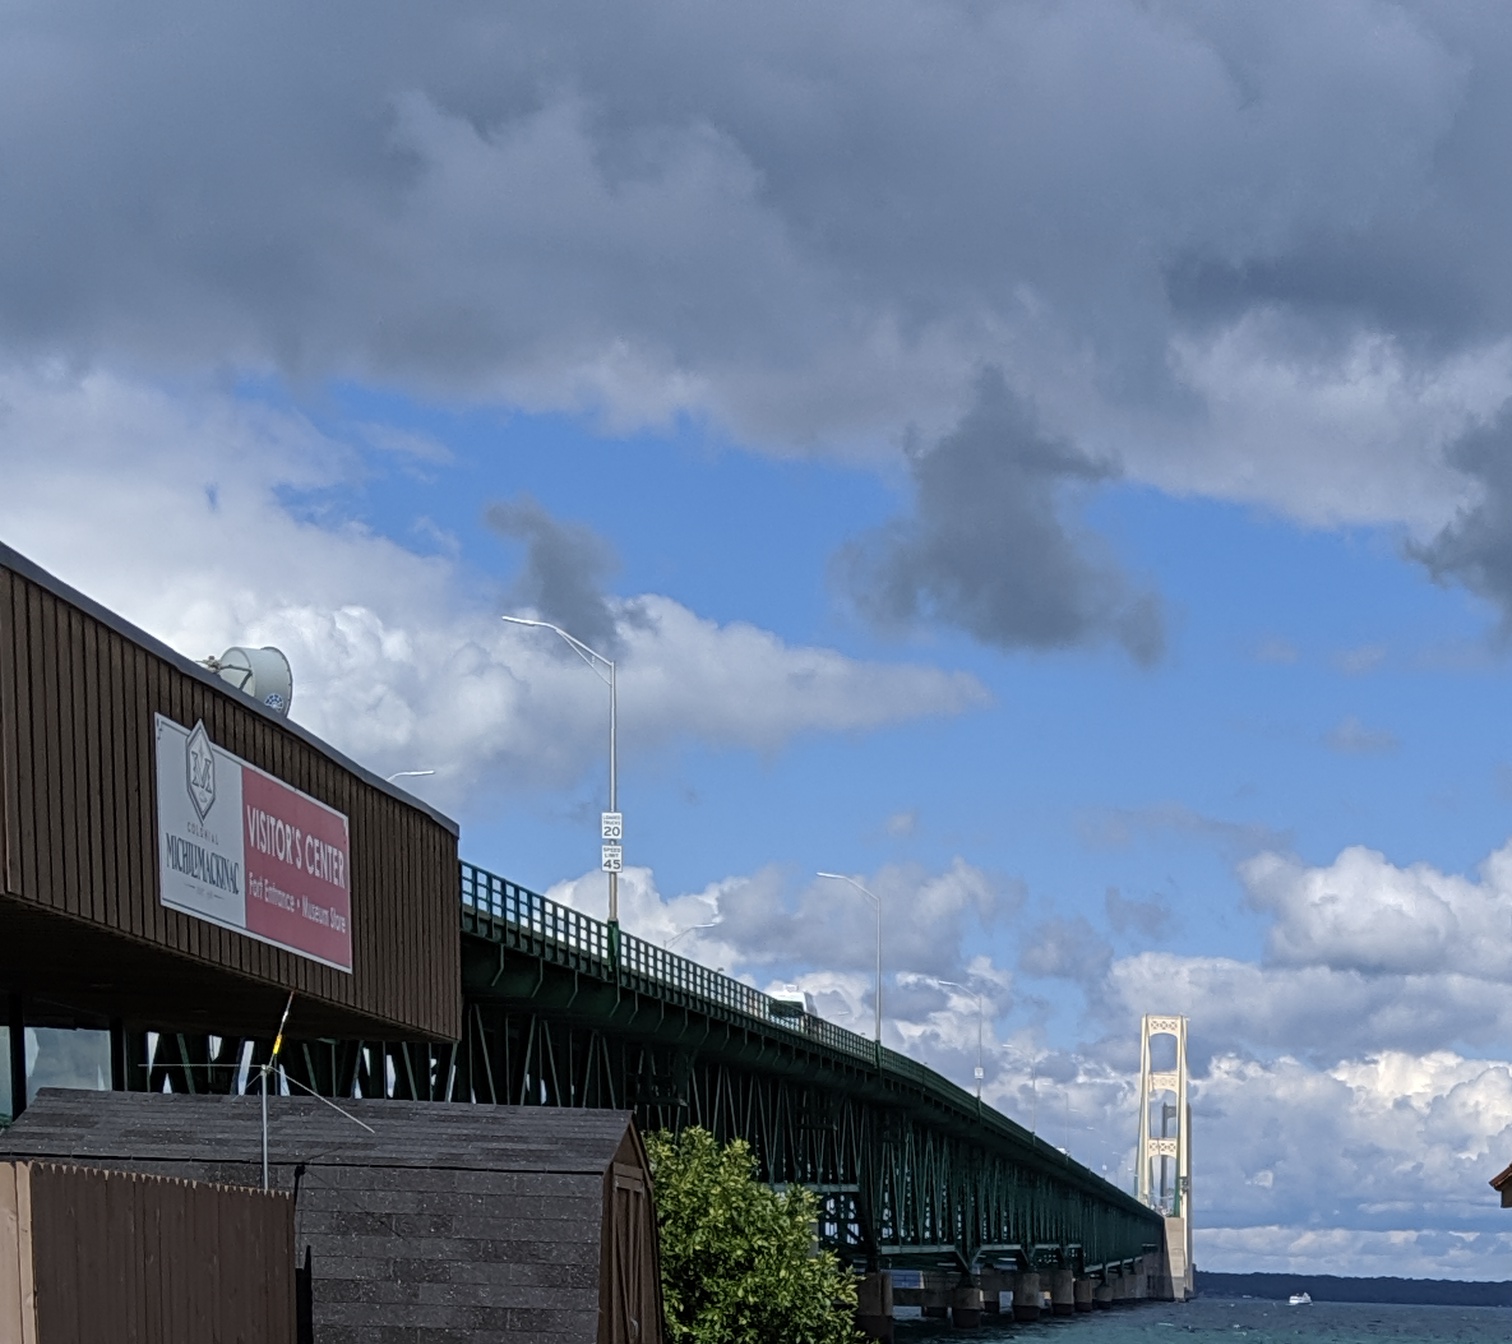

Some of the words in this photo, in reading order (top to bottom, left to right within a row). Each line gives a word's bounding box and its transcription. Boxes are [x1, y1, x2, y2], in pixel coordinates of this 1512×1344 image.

[186, 821, 219, 846] COLONIAL
[603, 826, 620, 837] 20
[246, 804, 302, 870] VISITOR'S
[304, 834, 346, 889] CENTER
[603, 859, 621, 870] 45
[248, 871, 263, 900] Fort
[264, 878, 295, 913] Entrance
[302, 894, 330, 926] Museum
[330, 906, 346, 934] Store
